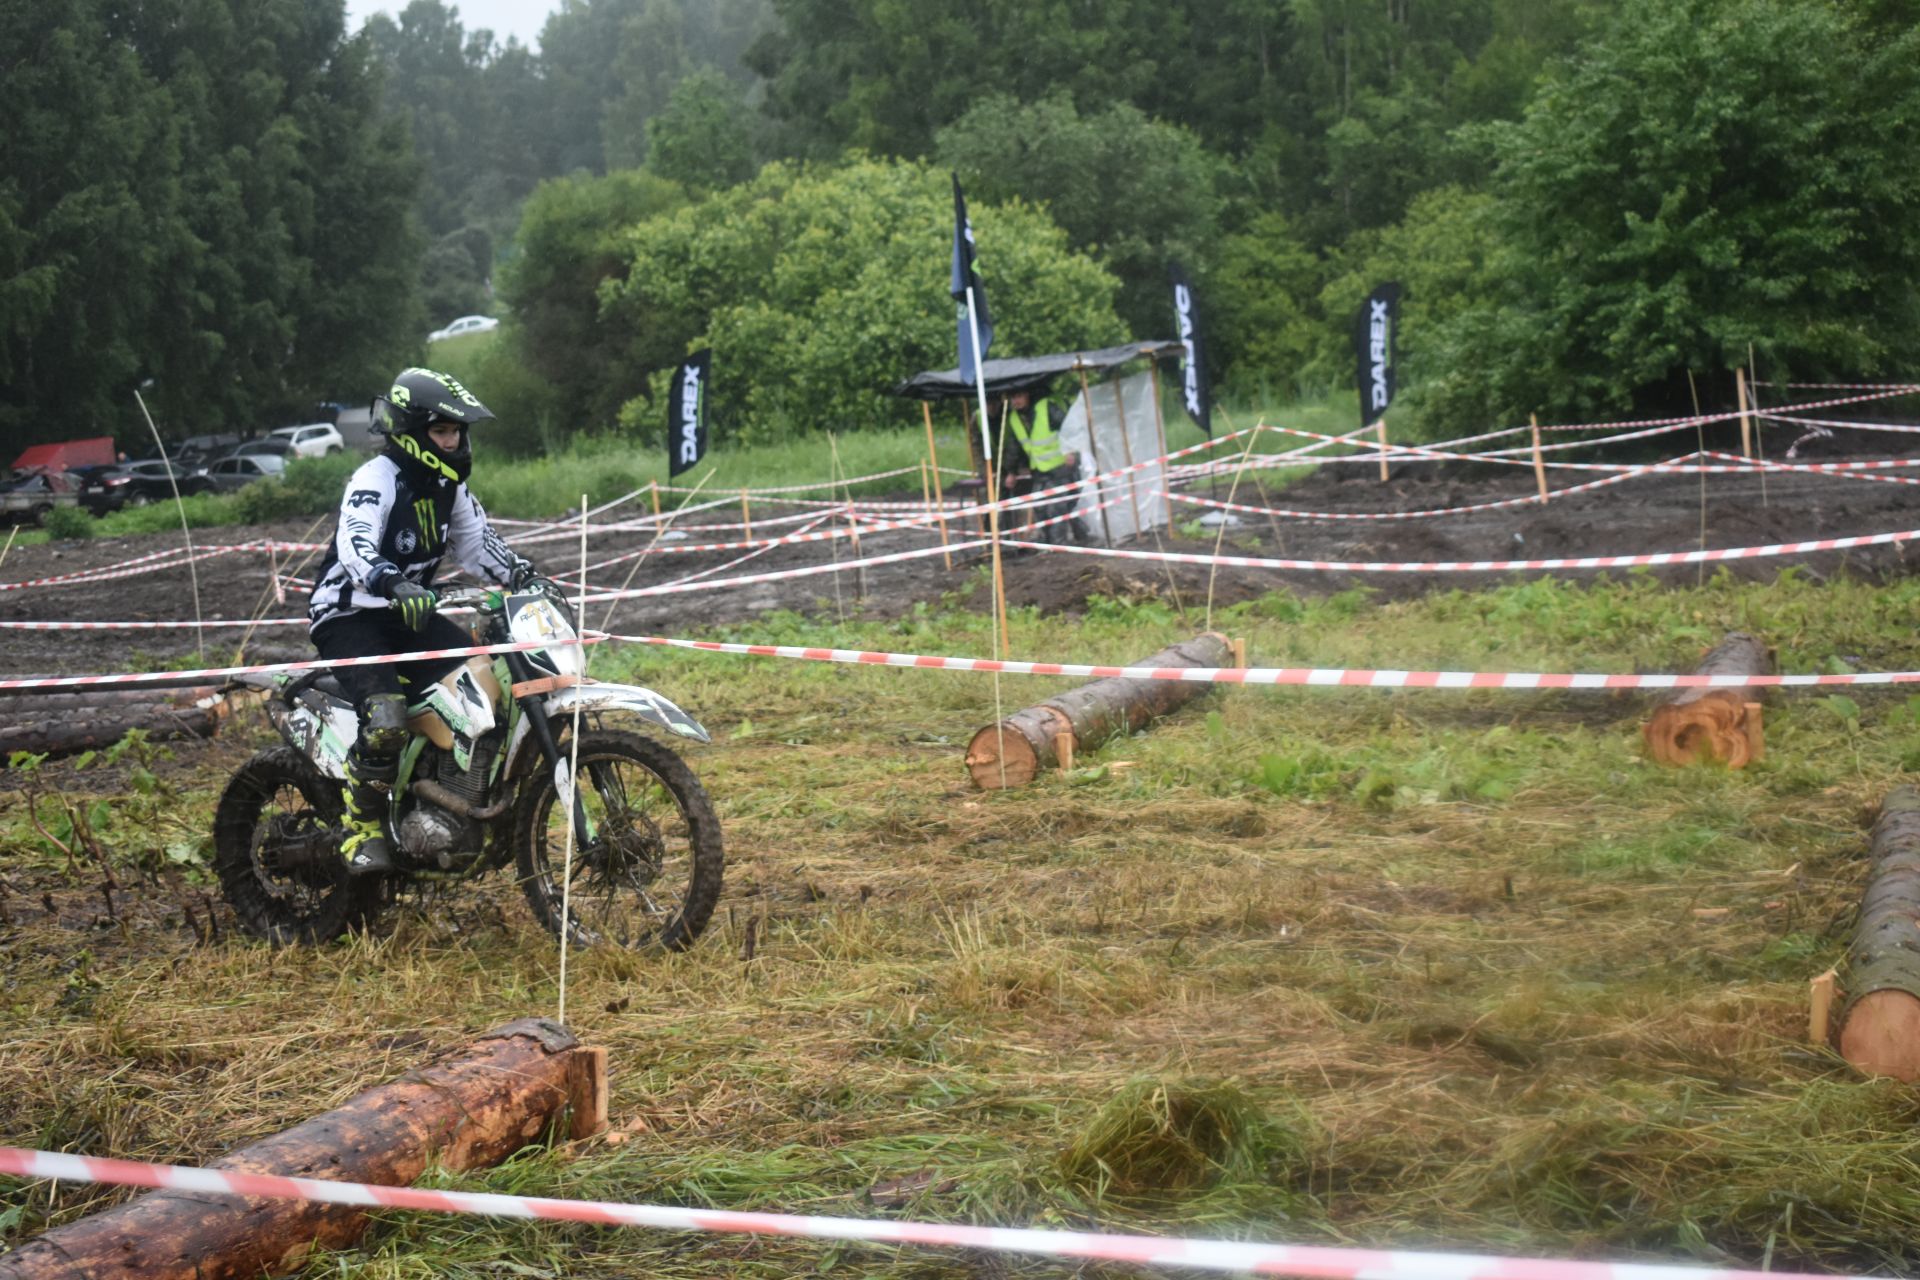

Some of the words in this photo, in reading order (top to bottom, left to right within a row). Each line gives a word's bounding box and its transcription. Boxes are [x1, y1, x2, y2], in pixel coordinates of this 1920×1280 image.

[1175, 284, 1201, 416] DAREX
[1370, 298, 1388, 411] DAREX
[680, 363, 701, 465] DAREX
